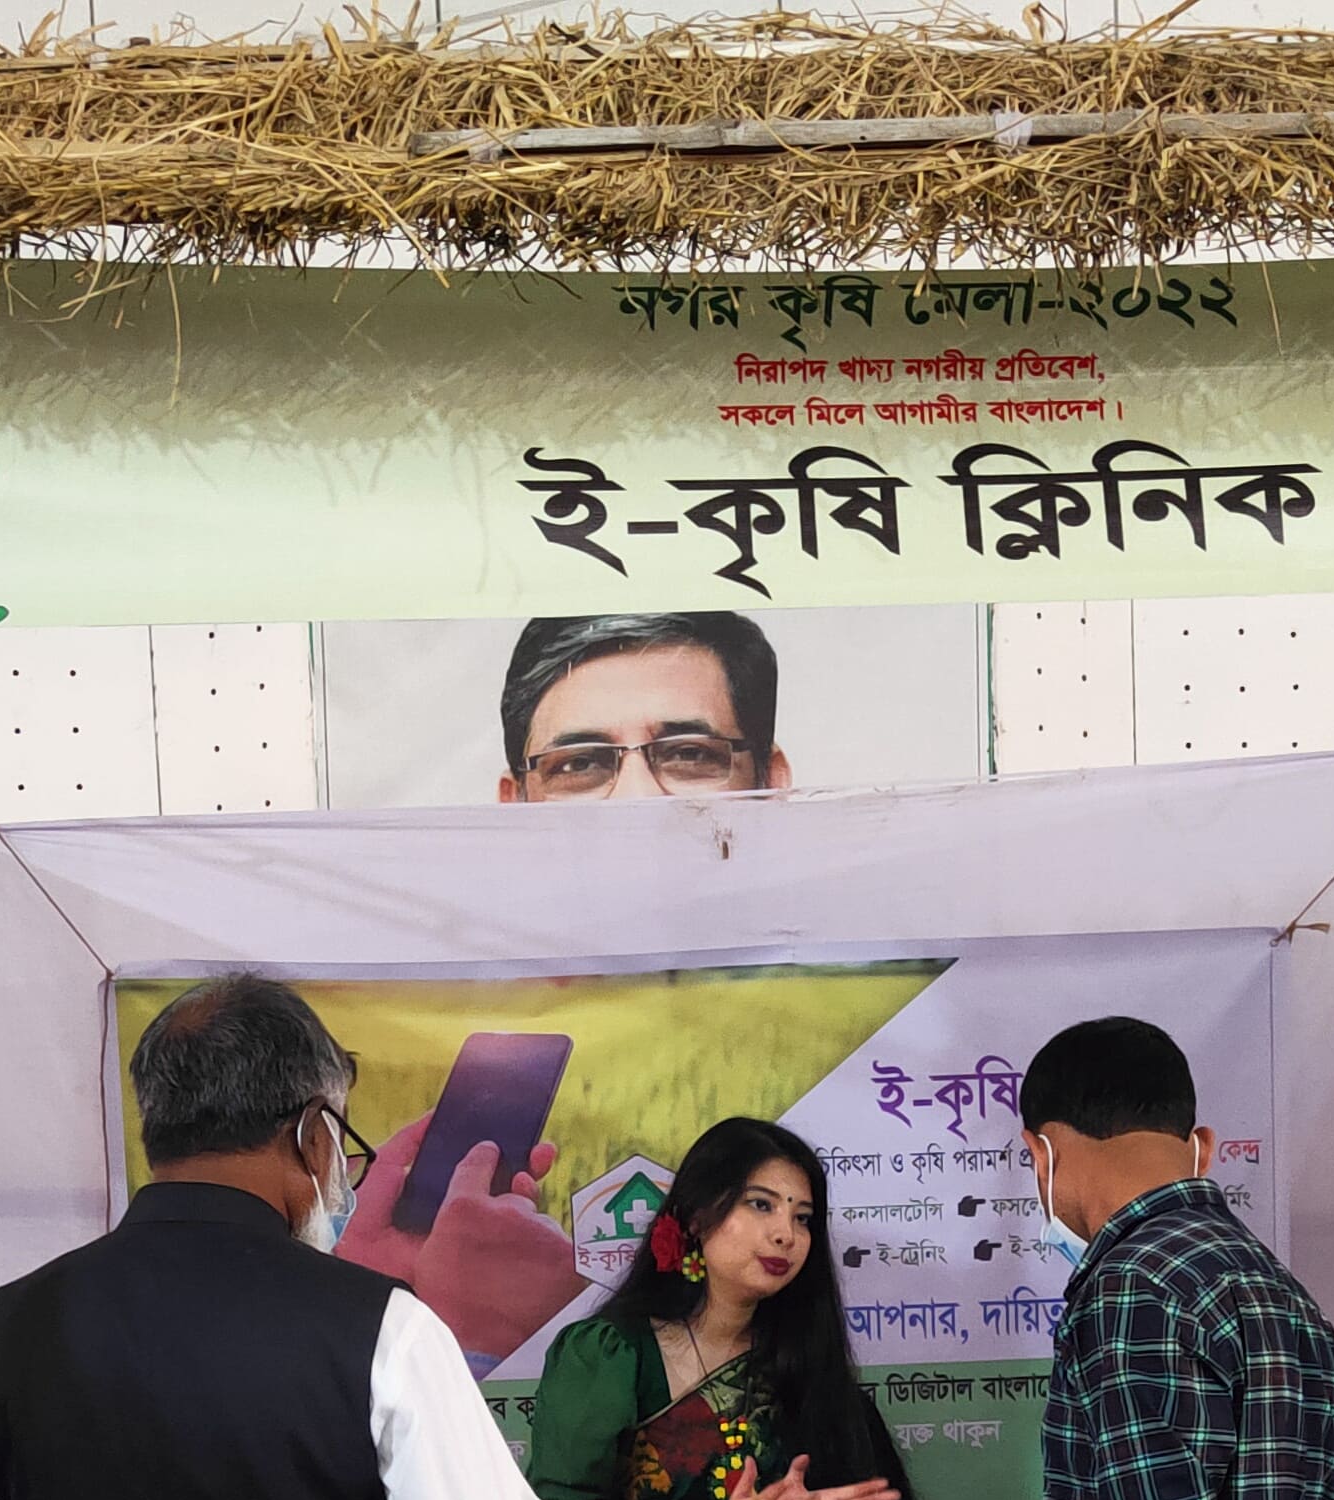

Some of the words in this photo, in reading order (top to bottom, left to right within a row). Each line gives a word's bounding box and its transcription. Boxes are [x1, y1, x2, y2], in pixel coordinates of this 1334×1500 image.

[762, 274, 883, 352] কৃষি
[733, 353, 827, 386] নিরাপদ
[838, 356, 894, 384] খাদ্য
[903, 350, 985, 384] নগরীয়
[995, 348, 1107, 385] প্রতিবেশ,
[717, 401, 796, 428] সকলে
[805, 396, 866, 427] মিলে
[874, 393, 977, 425] আগামীর
[517, 445, 913, 600] ই-কৃষি
[938, 438, 1324, 562] ক্লিনিক
[870, 1055, 1023, 1142] ই-কৃষি
[888, 1155, 905, 1176] ও
[910, 1147, 945, 1185] কৃষি
[952, 1141, 1014, 1175] পরামর্শ
[1218, 1138, 1263, 1165] কেন্দ্র
[843, 1303, 969, 1344] আপনার,
[883, 1373, 974, 1406] ডিজিটাল
[893, 1422, 936, 1451] যুক্ত
[940, 1418, 1003, 1449] থাকুন
